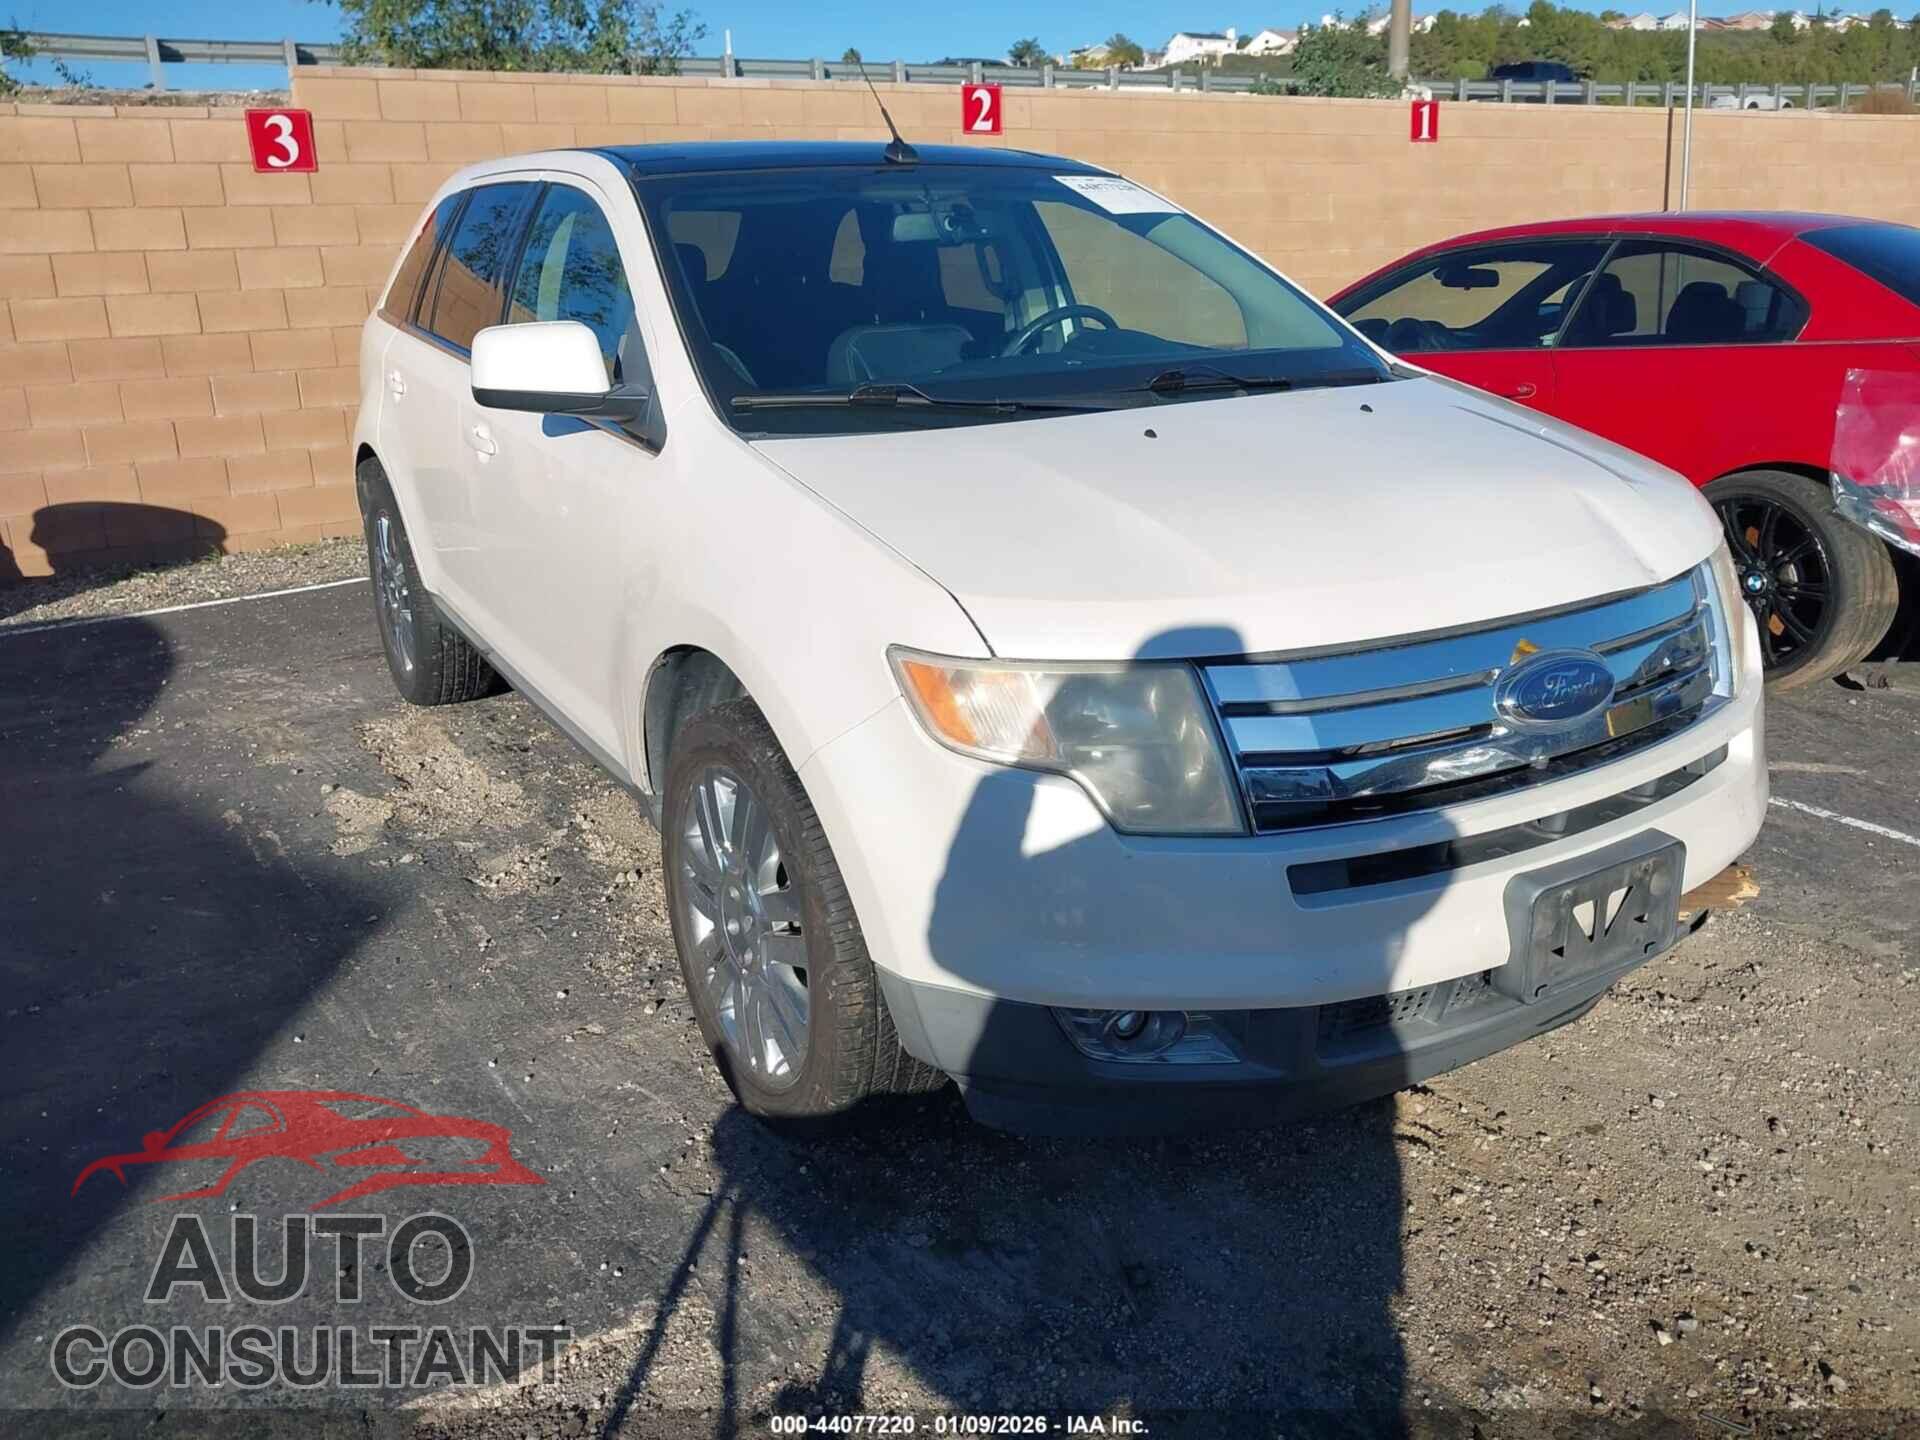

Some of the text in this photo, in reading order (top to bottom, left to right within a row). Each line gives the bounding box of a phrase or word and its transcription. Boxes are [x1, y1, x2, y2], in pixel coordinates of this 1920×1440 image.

[971, 88, 994, 131] 2
[1419, 103, 1432, 139] 1
[264, 114, 300, 168] 3
[1536, 668, 1599, 708] Ford
